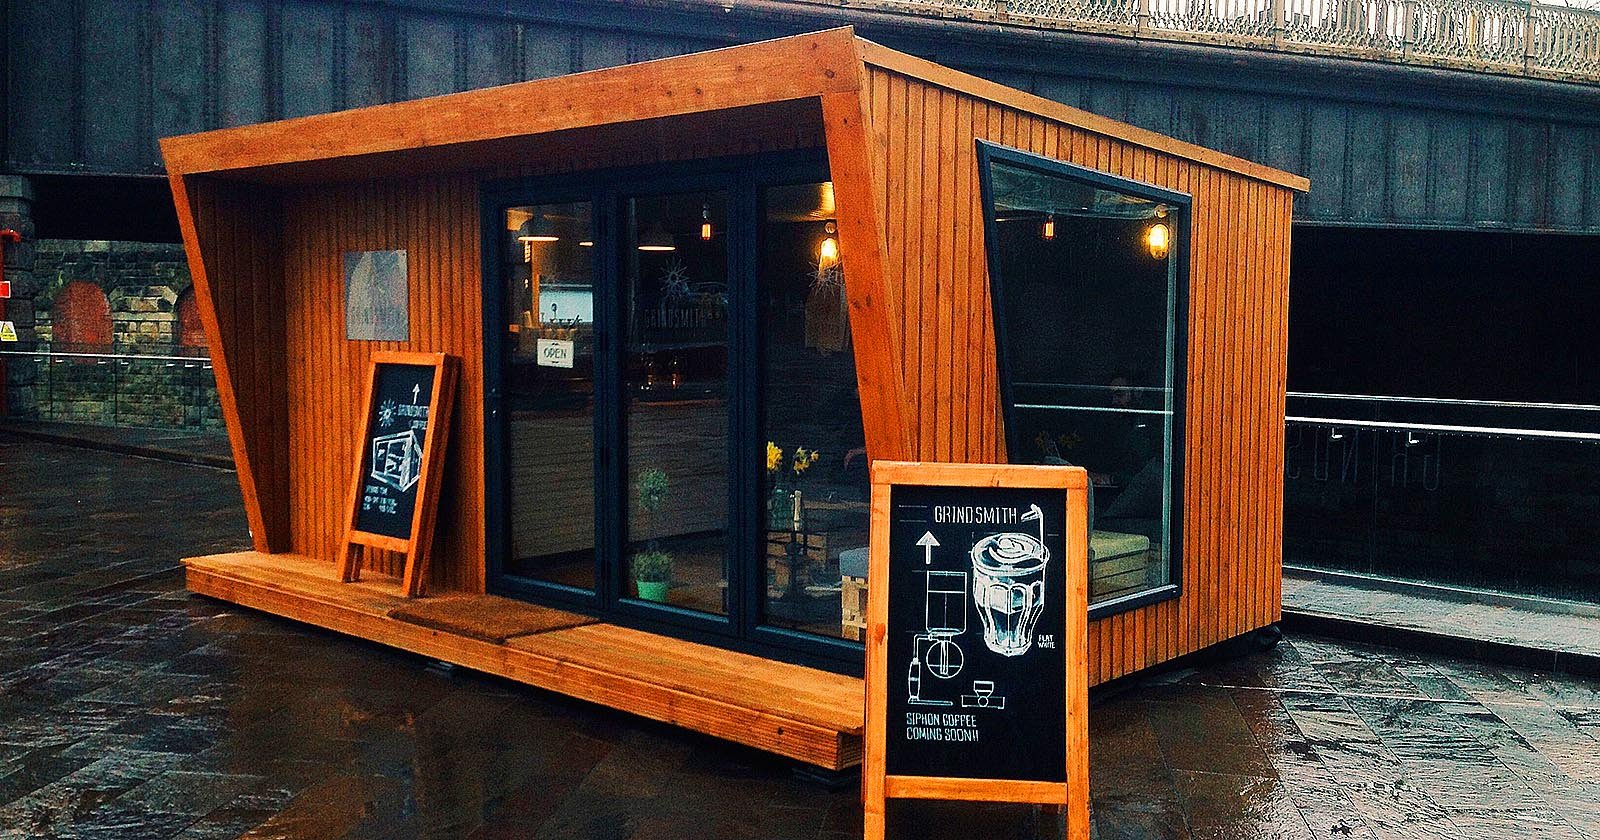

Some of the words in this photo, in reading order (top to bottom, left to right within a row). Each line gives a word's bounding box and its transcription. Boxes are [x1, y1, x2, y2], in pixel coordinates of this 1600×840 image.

[543, 347, 567, 359] OPEN
[934, 505, 1018, 524] GRINDSMITH
[1037, 641, 1056, 649] WHITE
[1038, 634, 1054, 643] FLAT
[906, 712, 940, 726] SIPHON
[942, 713, 977, 727] COFFEE
[906, 726, 943, 740] COMING
